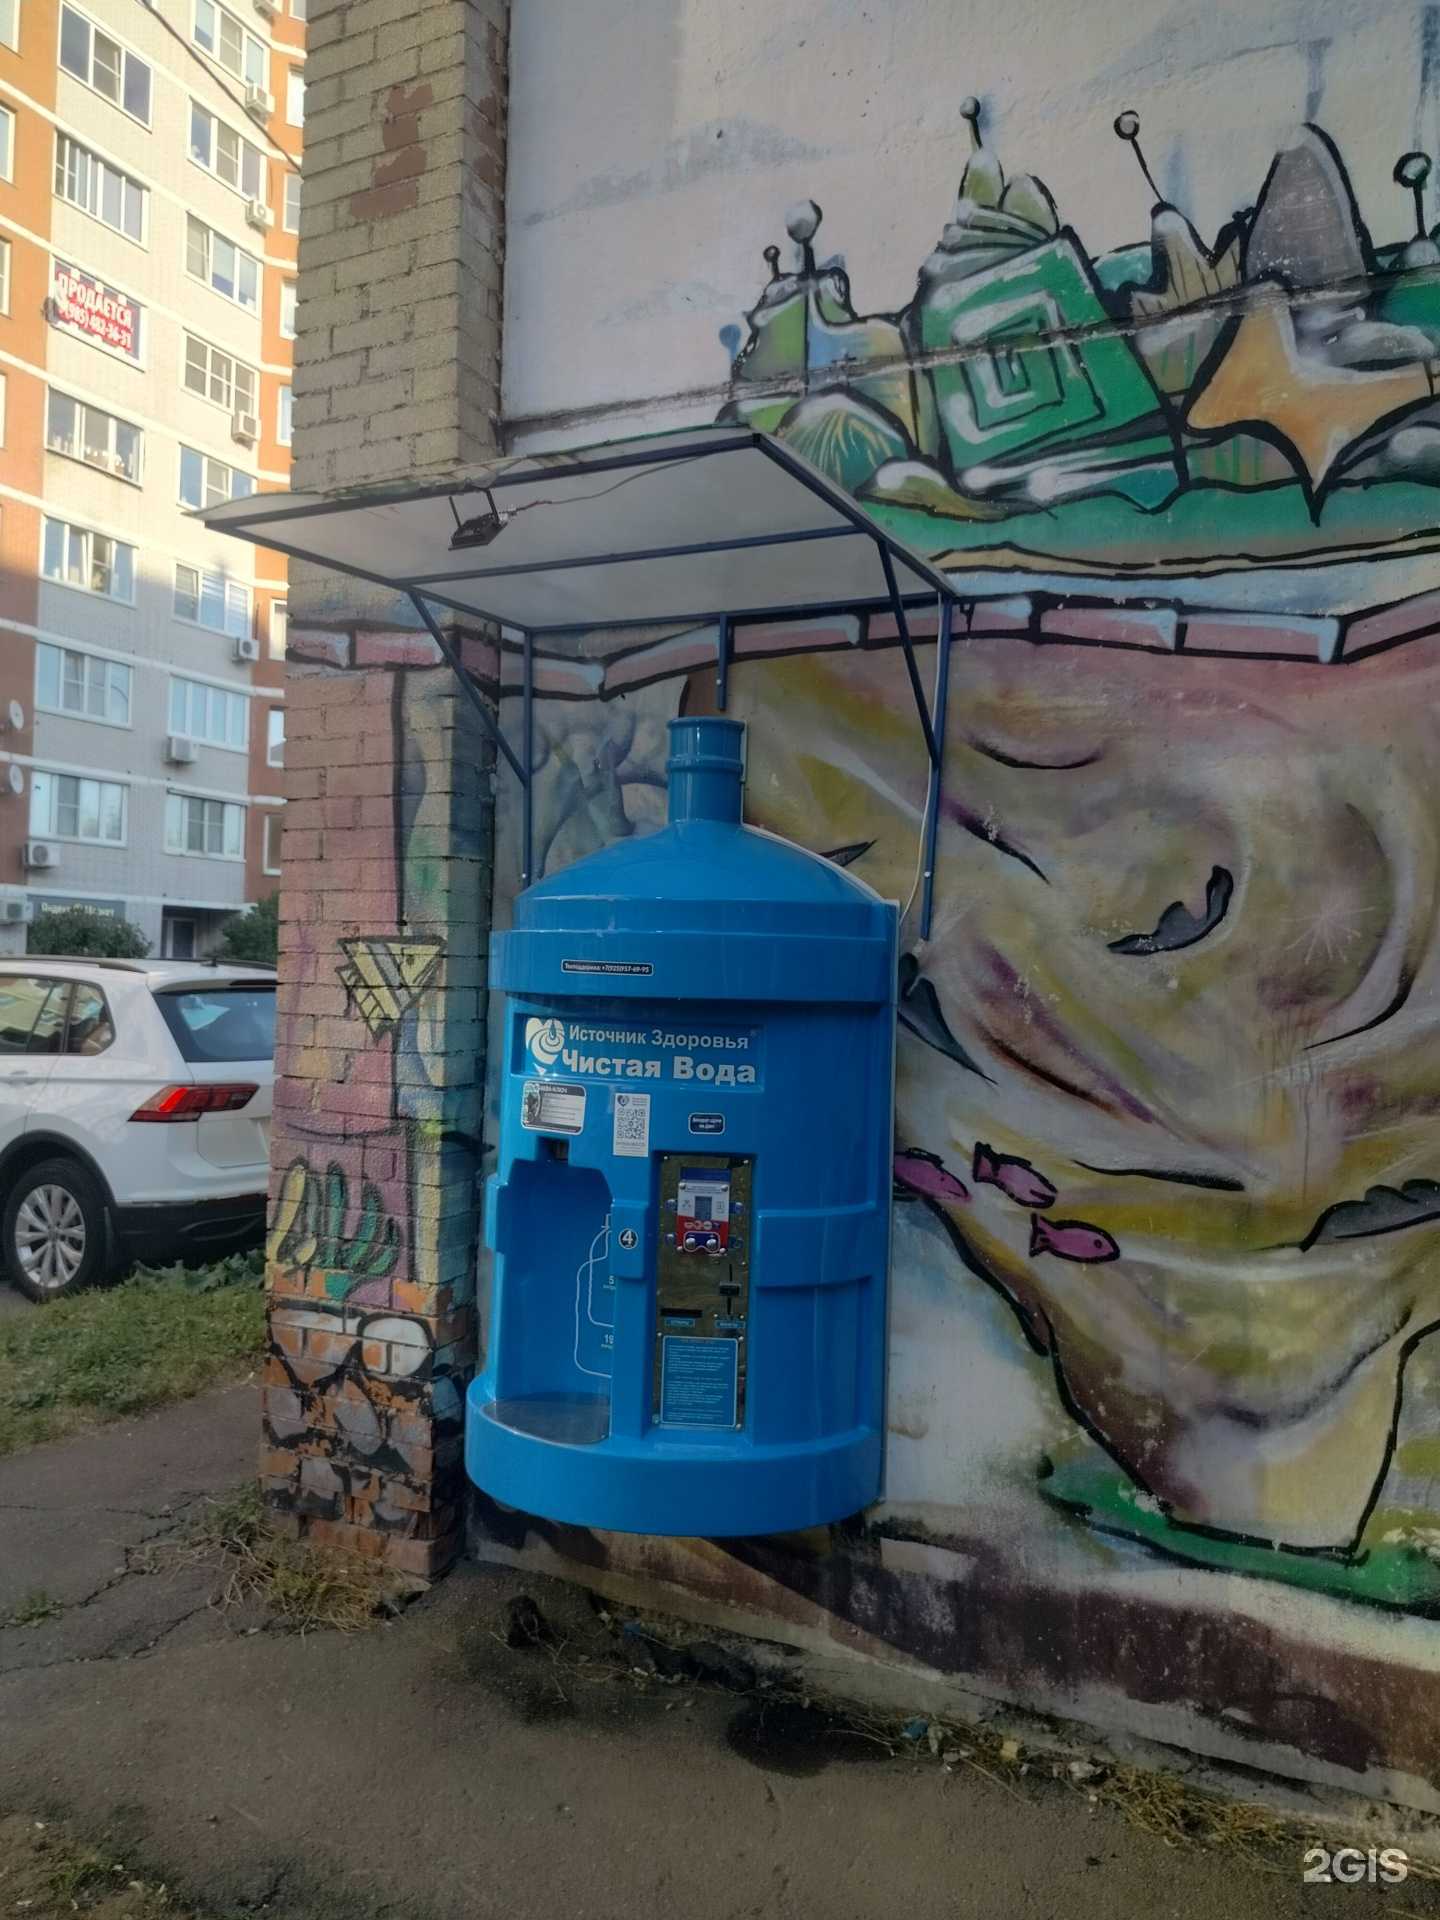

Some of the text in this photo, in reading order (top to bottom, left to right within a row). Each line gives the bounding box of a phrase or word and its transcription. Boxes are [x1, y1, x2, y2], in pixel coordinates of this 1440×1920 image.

[58, 273, 132, 328] ПРОДАЕТСЯ
[569, 1025, 749, 1050] Источник Здоровья
[562, 1048, 756, 1086] Чистая Вода
[622, 1230, 634, 1245] 4
